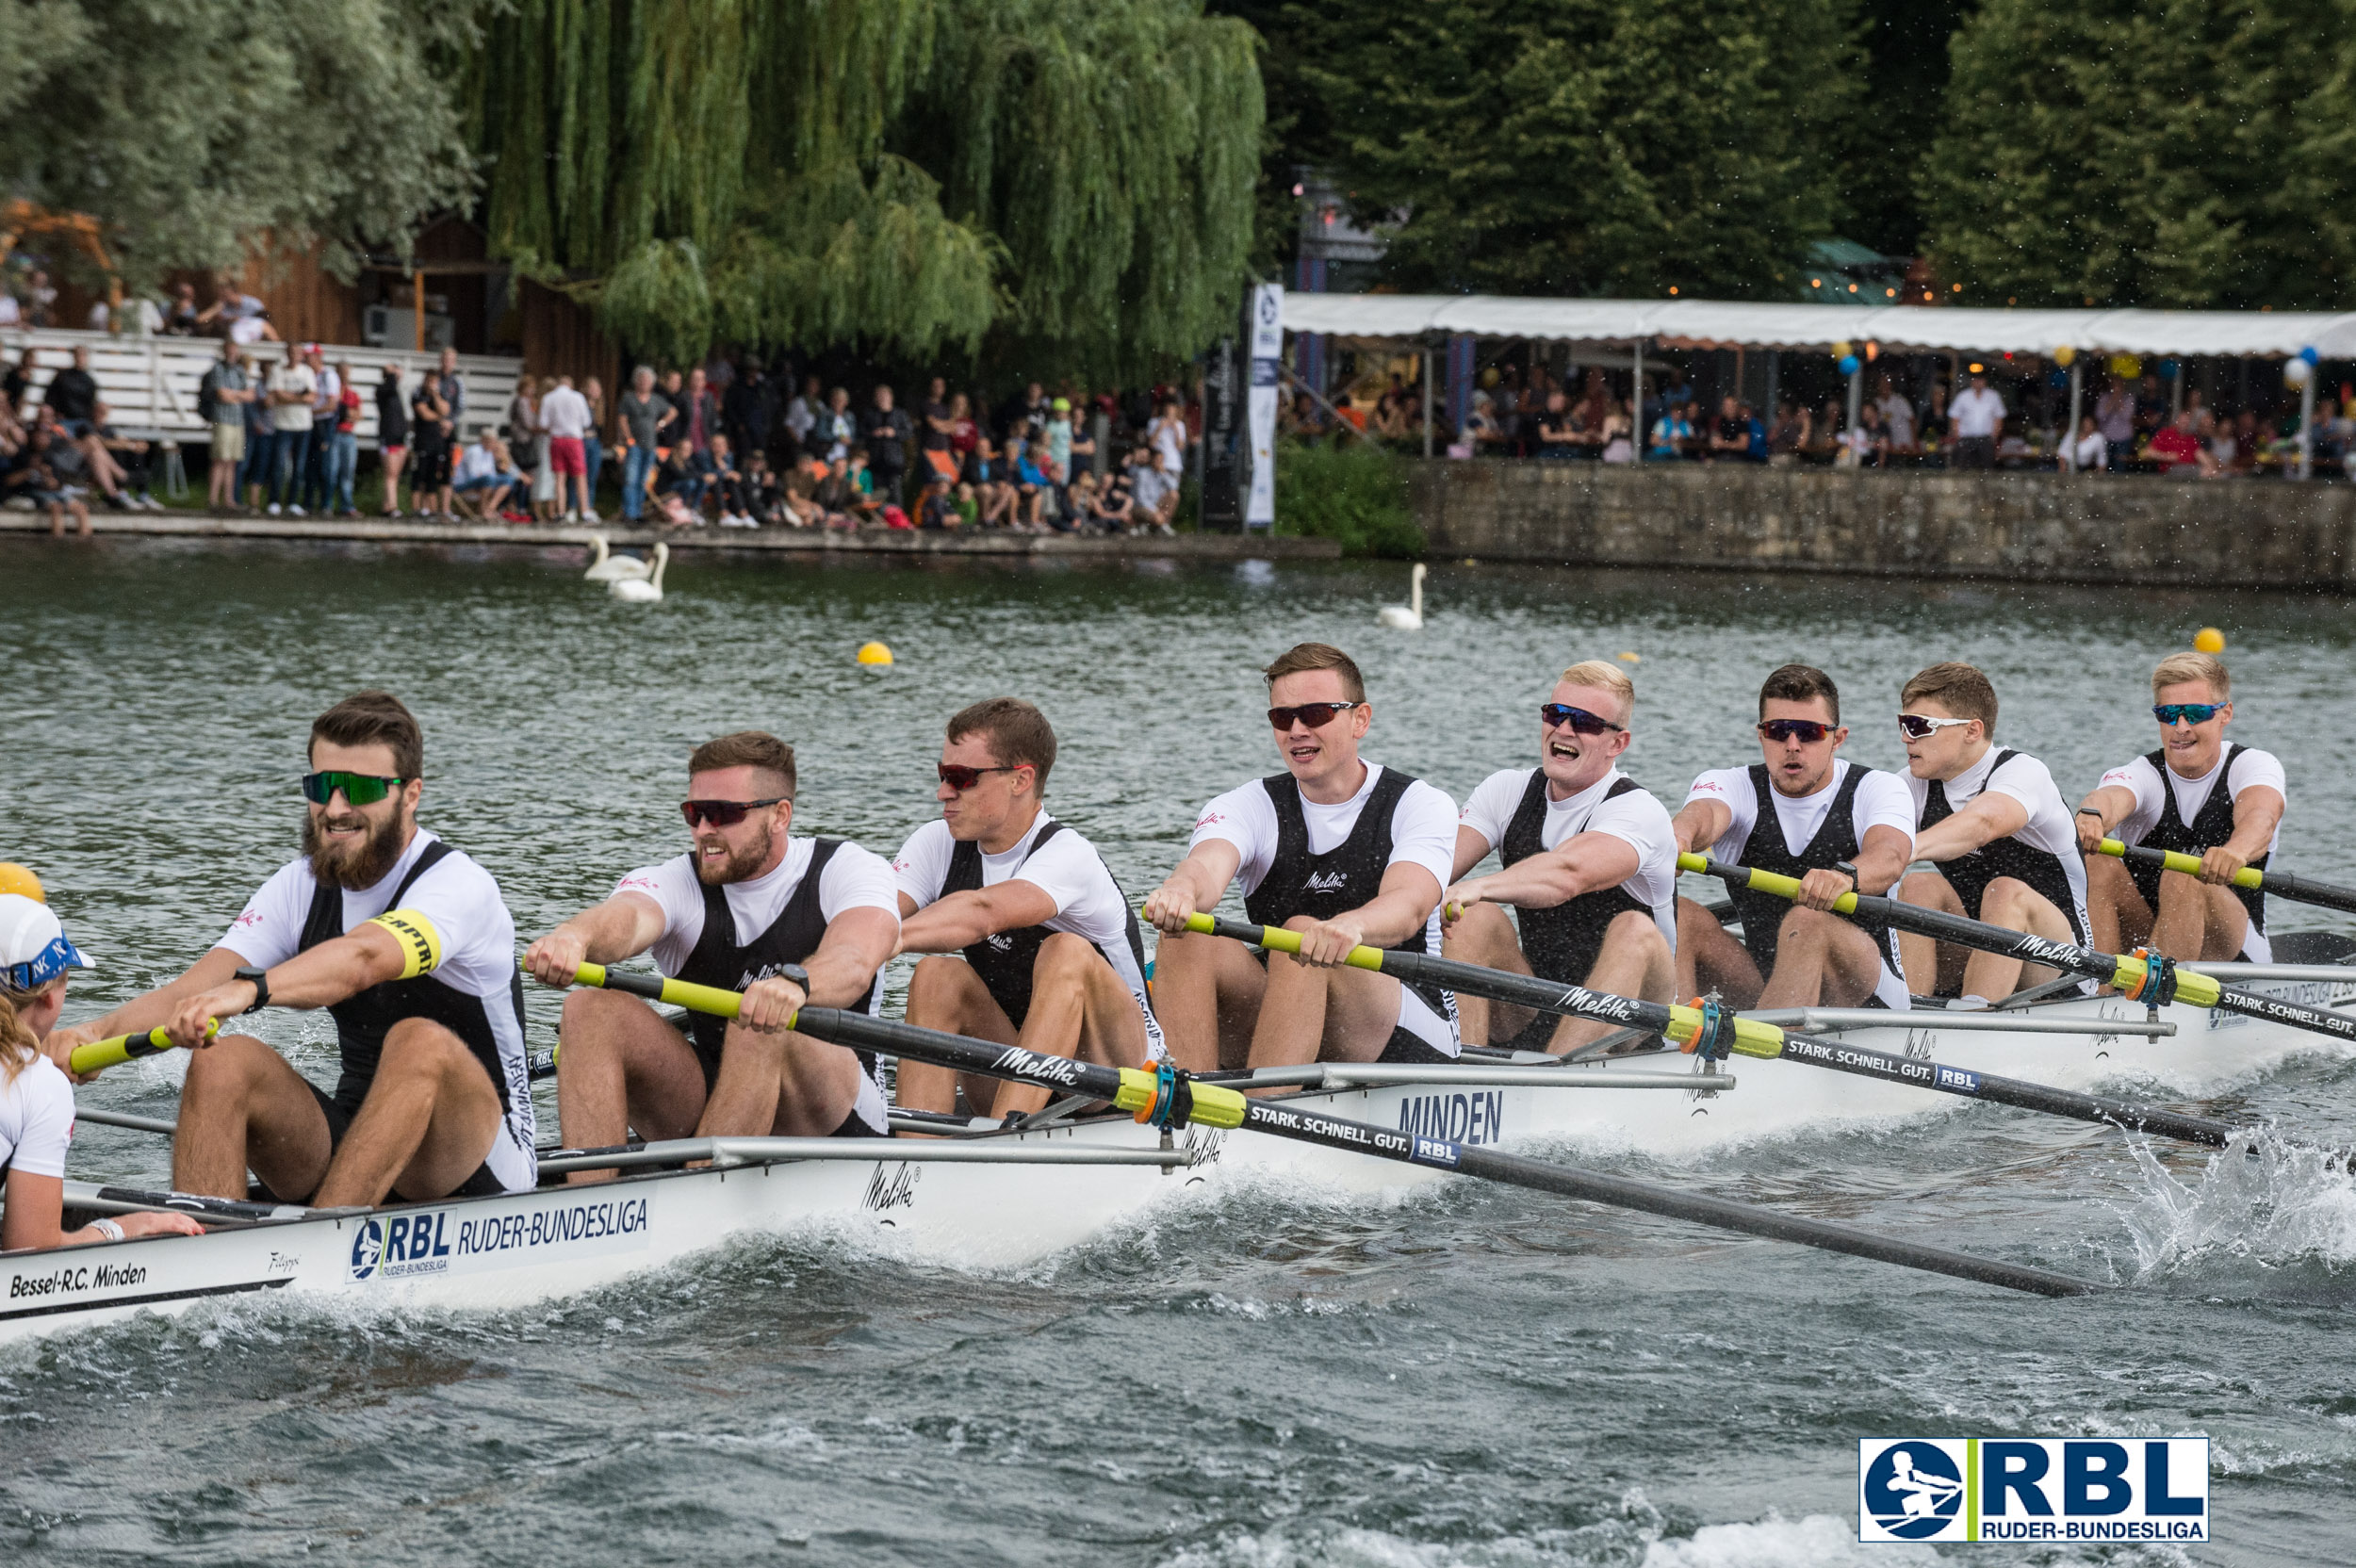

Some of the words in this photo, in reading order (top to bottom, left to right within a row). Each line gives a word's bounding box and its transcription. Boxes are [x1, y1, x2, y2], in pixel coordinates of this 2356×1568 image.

[2224, 992, 2266, 1012] STARK.
[537, 1051, 552, 1066] RBL
[1789, 1040, 1834, 1060] STARK.
[1837, 1051, 1898, 1074] SCHNELL.
[1901, 1064, 1931, 1080] GUT.
[1941, 1070, 1976, 1088] RBL
[1251, 1106, 1301, 1129] STARK.
[1303, 1118, 1371, 1145] SCHNELL.
[1375, 1133, 1407, 1152] GUT.
[1418, 1139, 1456, 1161] RBL
[1399, 1090, 1502, 1145] MINDEN
[385, 1212, 450, 1263] RBL
[458, 1199, 647, 1255] RUDER-BUNDESLIGA
[10, 1269, 88, 1298] Bessel-R.C.
[93, 1263, 146, 1289] Minden
